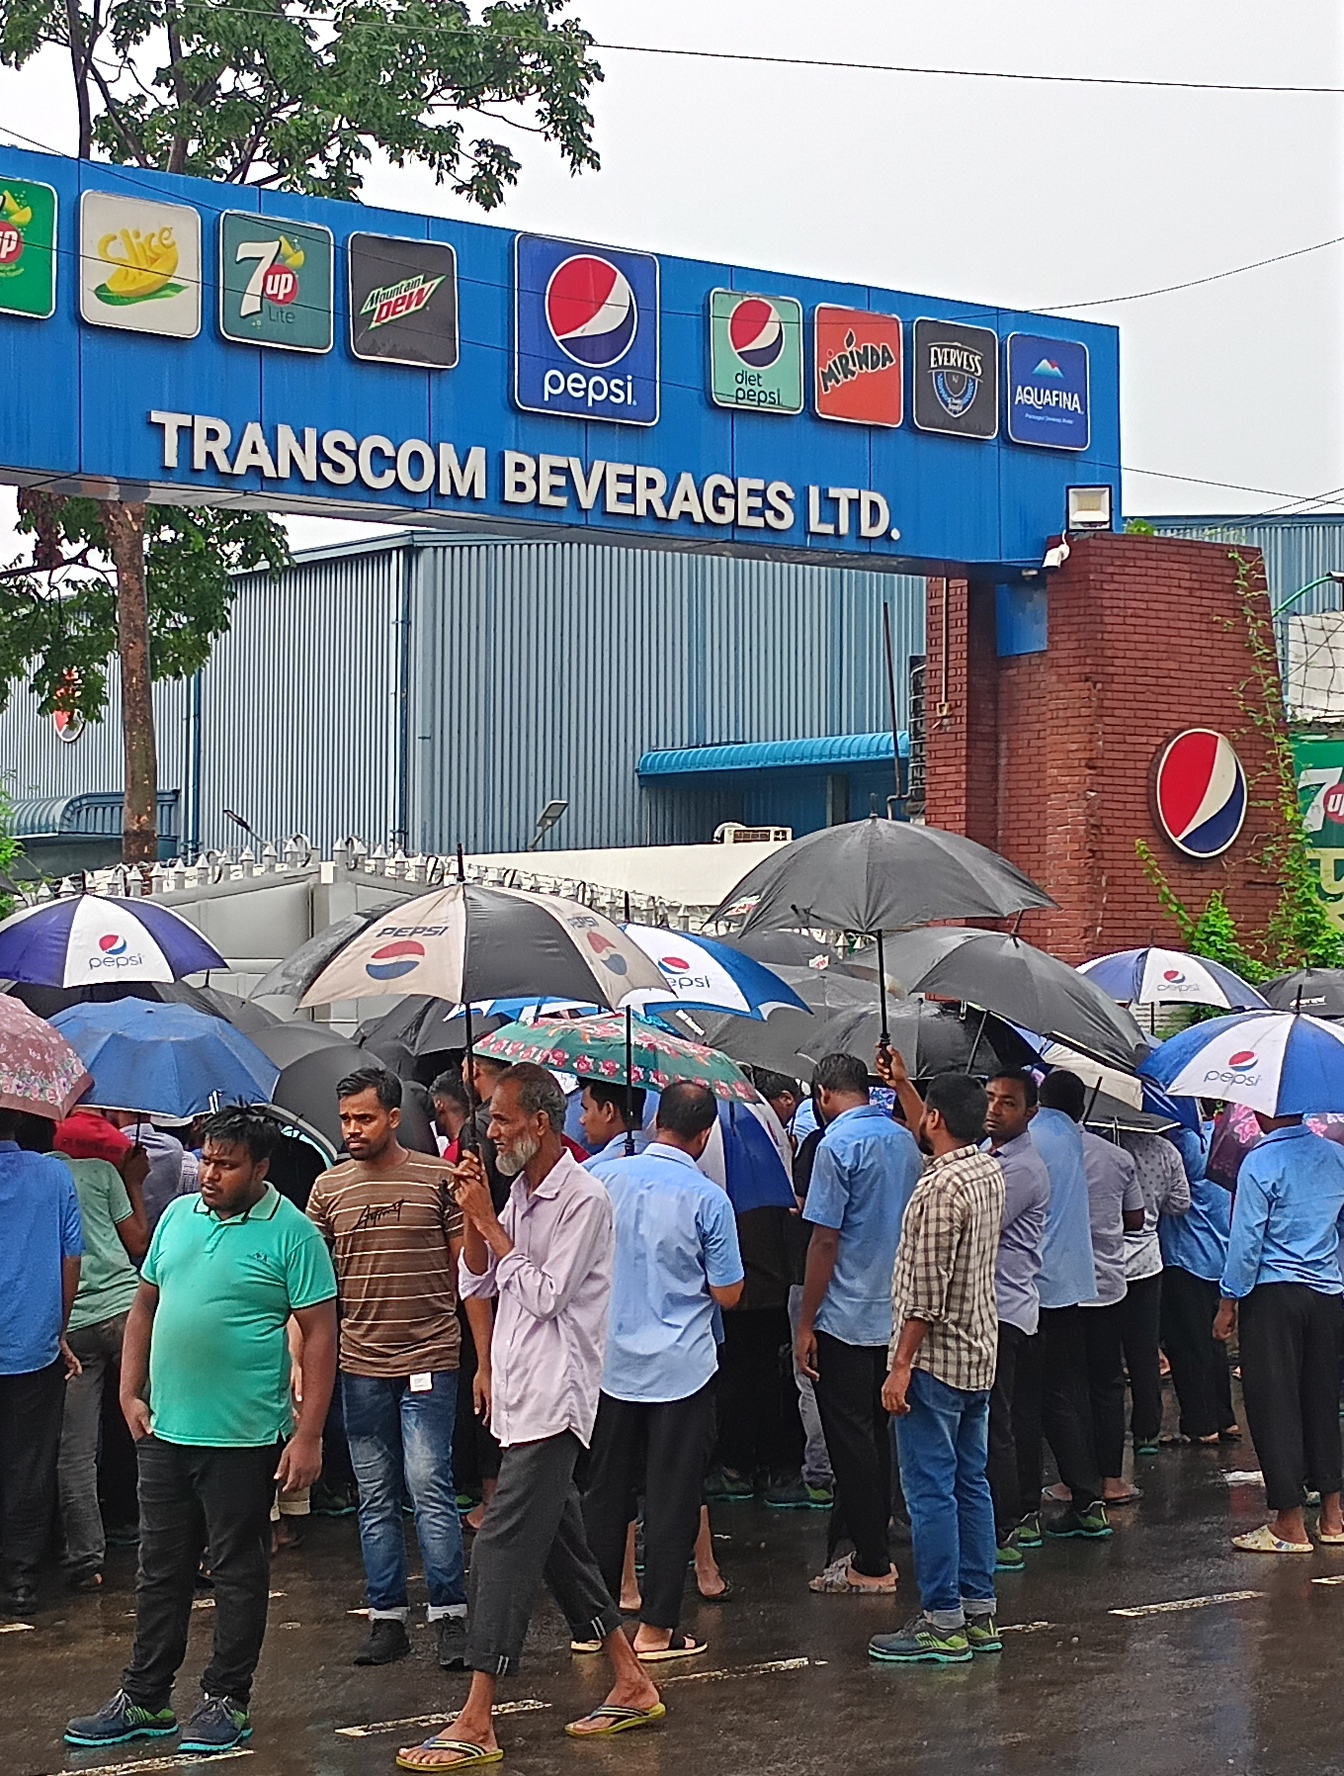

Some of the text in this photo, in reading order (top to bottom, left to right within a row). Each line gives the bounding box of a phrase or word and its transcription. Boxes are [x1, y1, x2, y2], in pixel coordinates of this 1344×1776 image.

[366, 277, 422, 309] Mountain
[268, 305, 296, 324] Lite
[930, 346, 983, 377] EVERVESS
[543, 367, 635, 407] pepsi
[735, 370, 763, 387] diet
[735, 387, 781, 407] pepsi
[1015, 385, 1082, 414] AQUAFINA
[149, 410, 901, 541] TRANSCOM BEVERAGES LTD.
[375, 924, 449, 939] PEPSI
[88, 953, 143, 970] pepsi
[668, 974, 711, 989] epsi
[1203, 1069, 1260, 1087] pepsi
